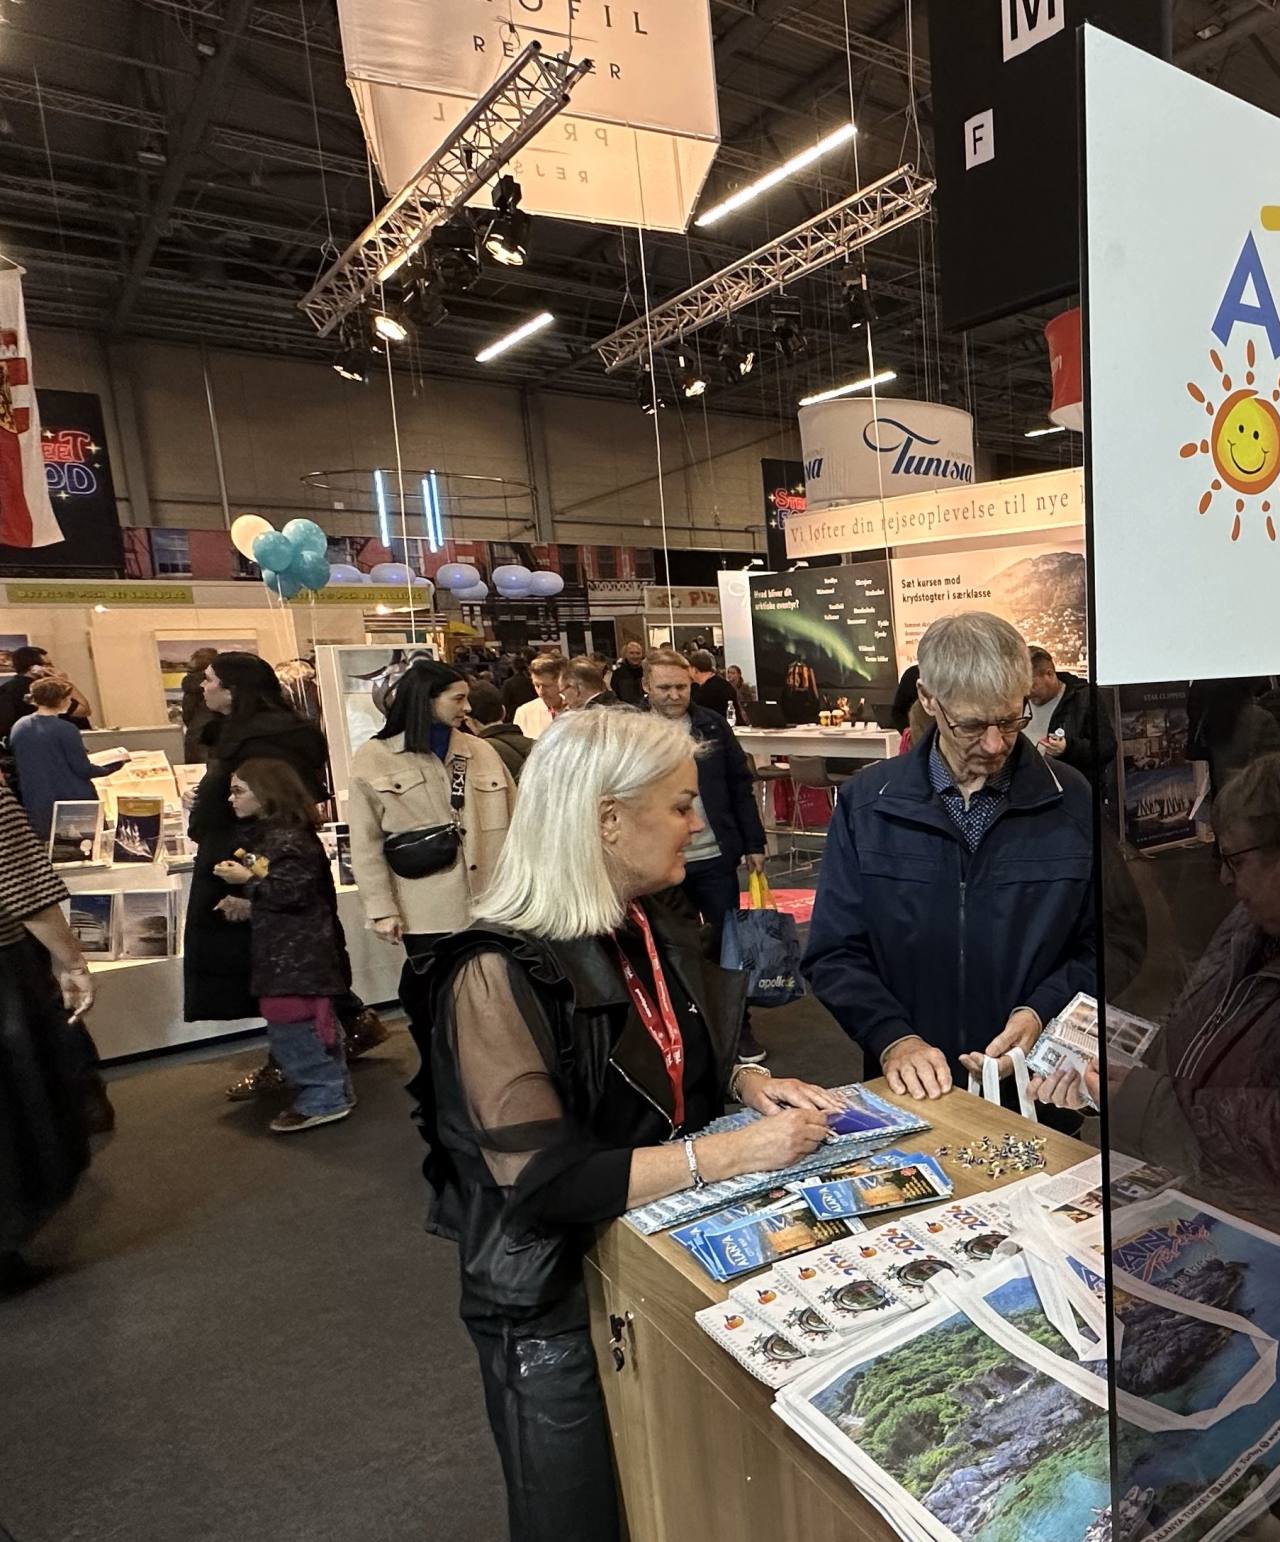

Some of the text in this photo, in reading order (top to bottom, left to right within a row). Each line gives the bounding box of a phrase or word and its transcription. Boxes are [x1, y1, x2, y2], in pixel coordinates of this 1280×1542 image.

[973, 124, 984, 155] F
[863, 418, 973, 484] Tunisia
[790, 527, 804, 544] Vi
[809, 520, 846, 541] løfter
[853, 517, 874, 535] din
[881, 501, 995, 535] rejseoplevelse
[1005, 494, 1026, 515] til
[1036, 492, 1069, 515] nye
[901, 575, 960, 589] Sæt kursen mod
[688, 591, 718, 606] PIZ
[902, 589, 991, 605] krydstogter i særklasse
[944, 1204, 987, 1230] 2024
[721, 1234, 749, 1265] ALANYA
[881, 1227, 924, 1256] 2024
[1154, 1517, 1184, 1542] ALANYA
